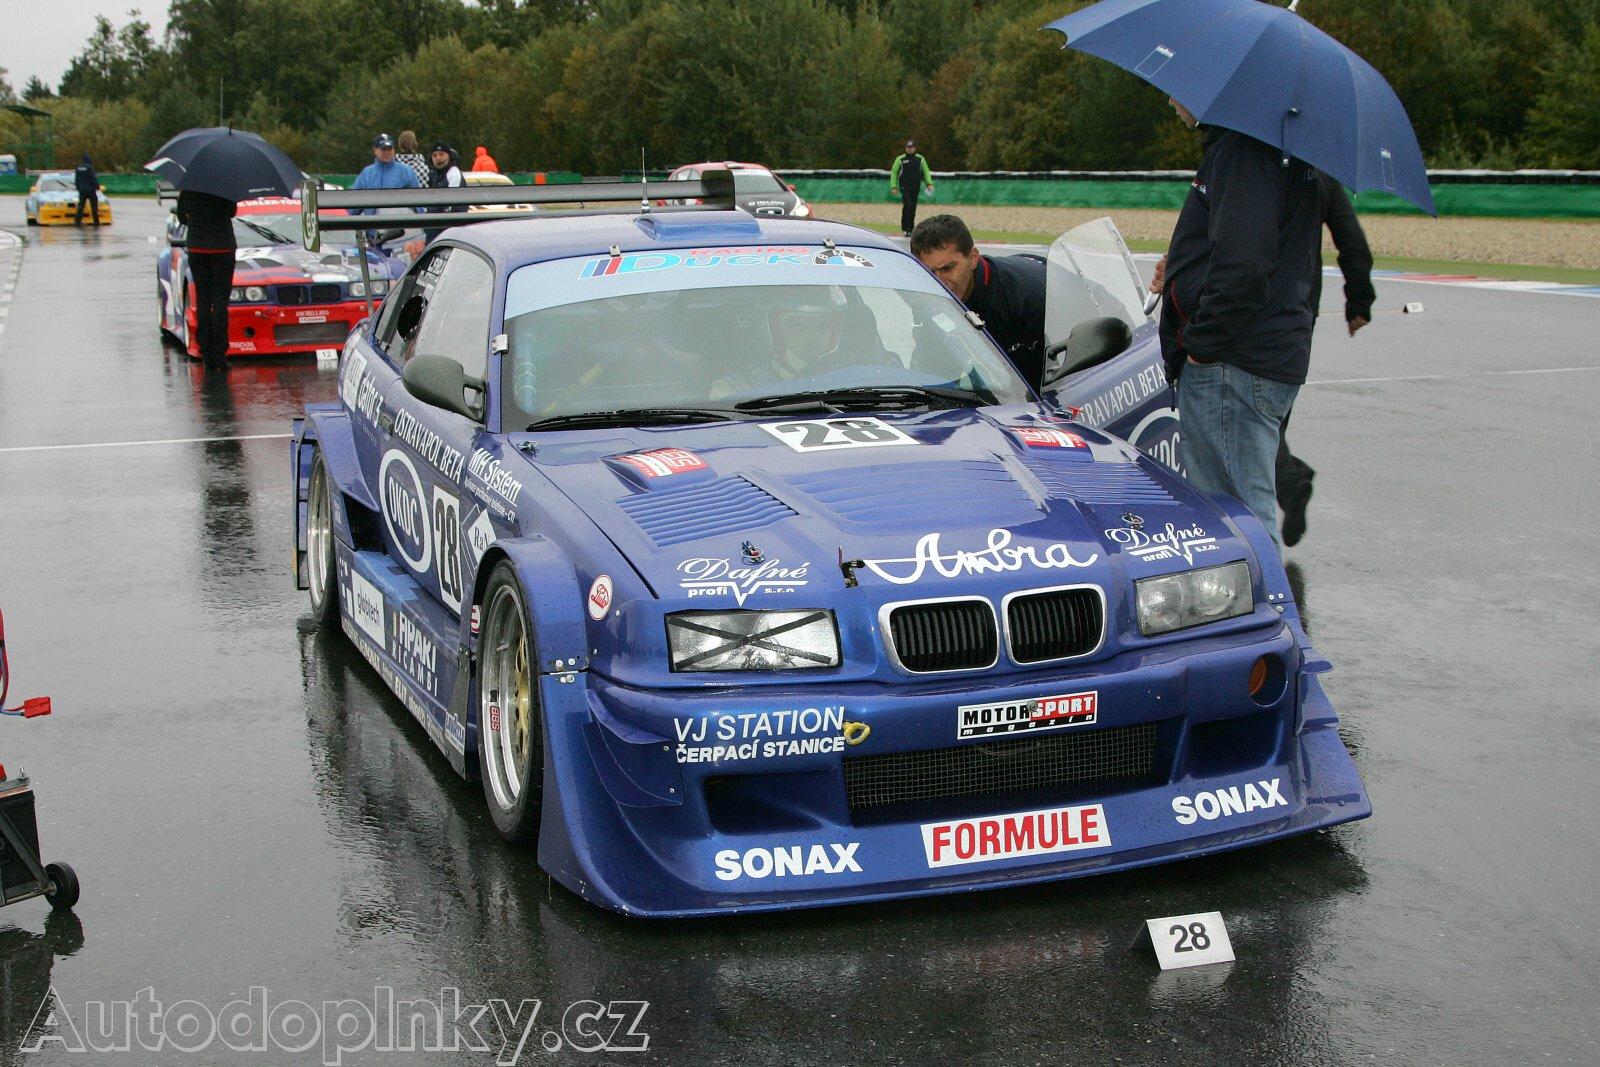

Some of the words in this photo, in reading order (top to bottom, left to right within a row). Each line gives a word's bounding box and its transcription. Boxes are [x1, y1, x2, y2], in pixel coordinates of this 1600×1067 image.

[690, 246, 811, 255] RACING
[817, 250, 869, 264] BMW
[1137, 362, 1168, 397] BETA
[394, 408, 443, 467] OSTRAVAPOL
[440, 445, 465, 484] BETA
[775, 420, 901, 448] 28
[468, 447, 494, 474] MH
[435, 498, 462, 603] 28
[864, 528, 1099, 585] Ambra
[676, 557, 811, 588] Dafné
[687, 586, 728, 599] profi
[392, 639, 438, 697] RICAMBI
[490, 705, 501, 732] BBS
[673, 717, 708, 742] VJ
[716, 706, 845, 741] STATION
[676, 740, 759, 763] ČERPACÍ
[763, 736, 846, 758] STANICE
[1171, 778, 1288, 825] SONAX
[931, 808, 1101, 862] FORMULE
[714, 842, 863, 881] SONAX
[1168, 921, 1211, 954] 28
